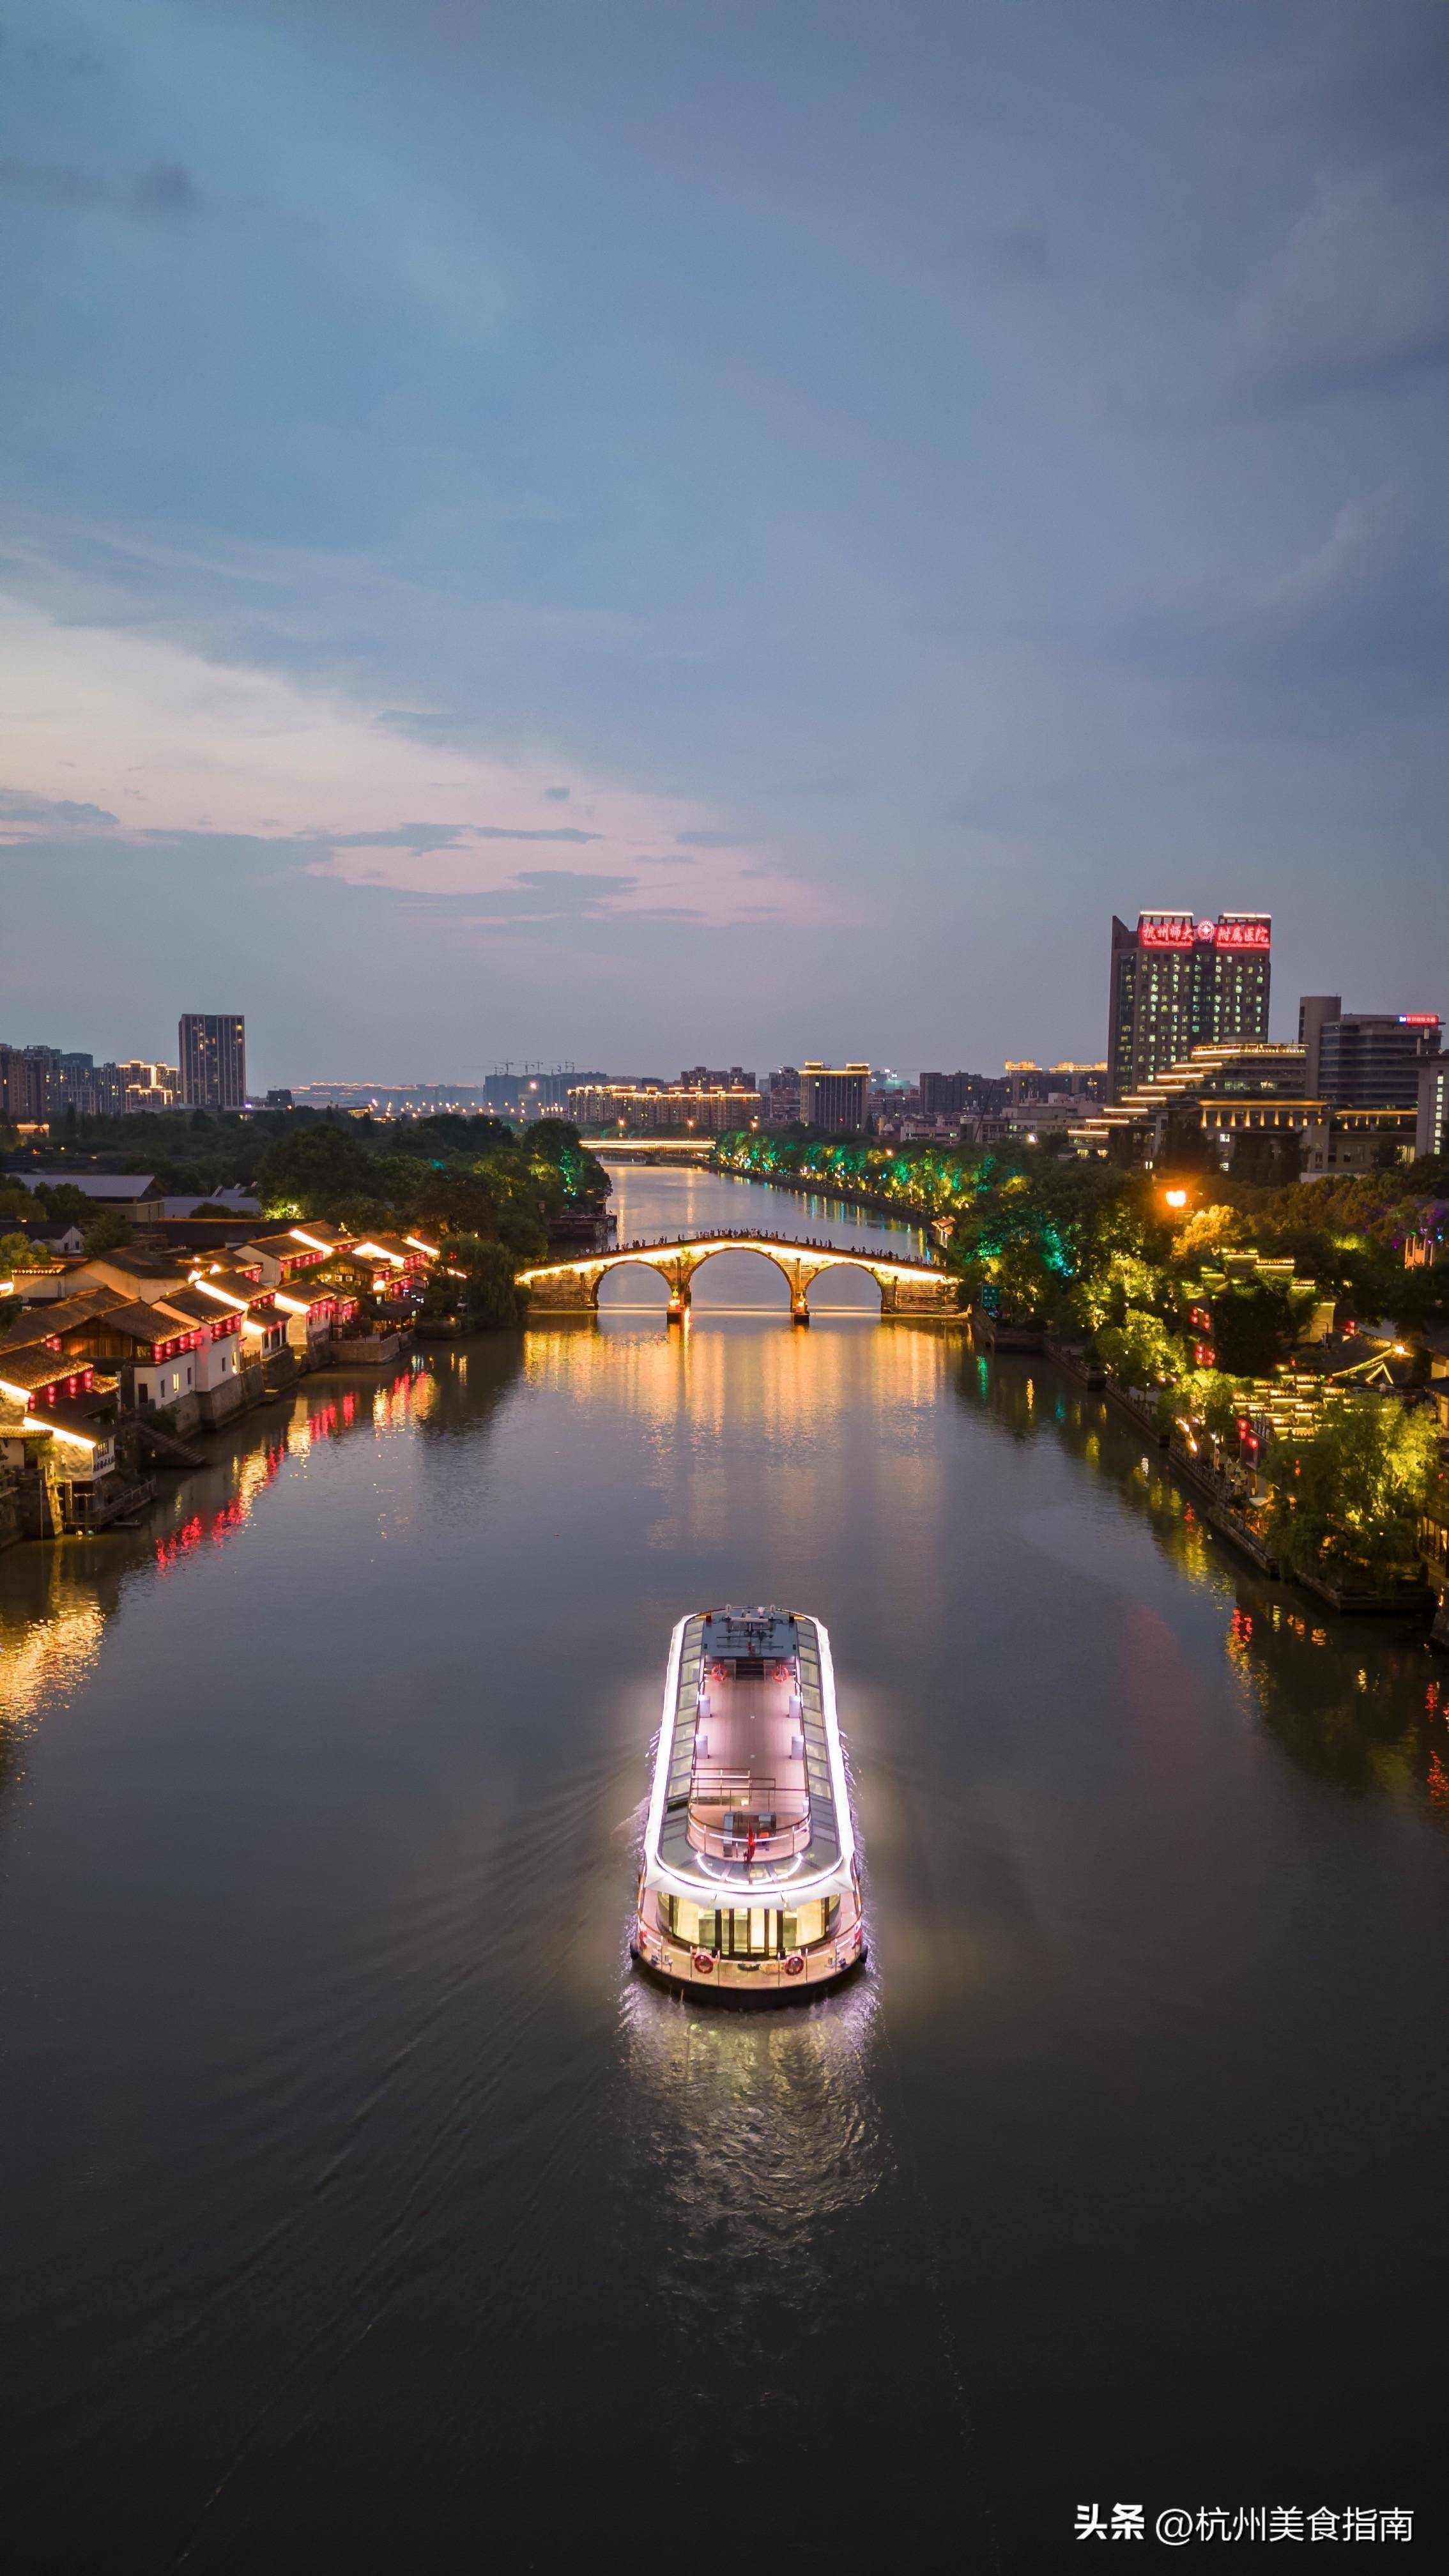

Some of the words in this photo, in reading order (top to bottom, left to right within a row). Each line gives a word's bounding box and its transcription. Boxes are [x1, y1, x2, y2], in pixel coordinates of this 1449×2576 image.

[1143, 924, 1194, 940] 杭州师大
[1218, 925, 1269, 942] 附属医院
